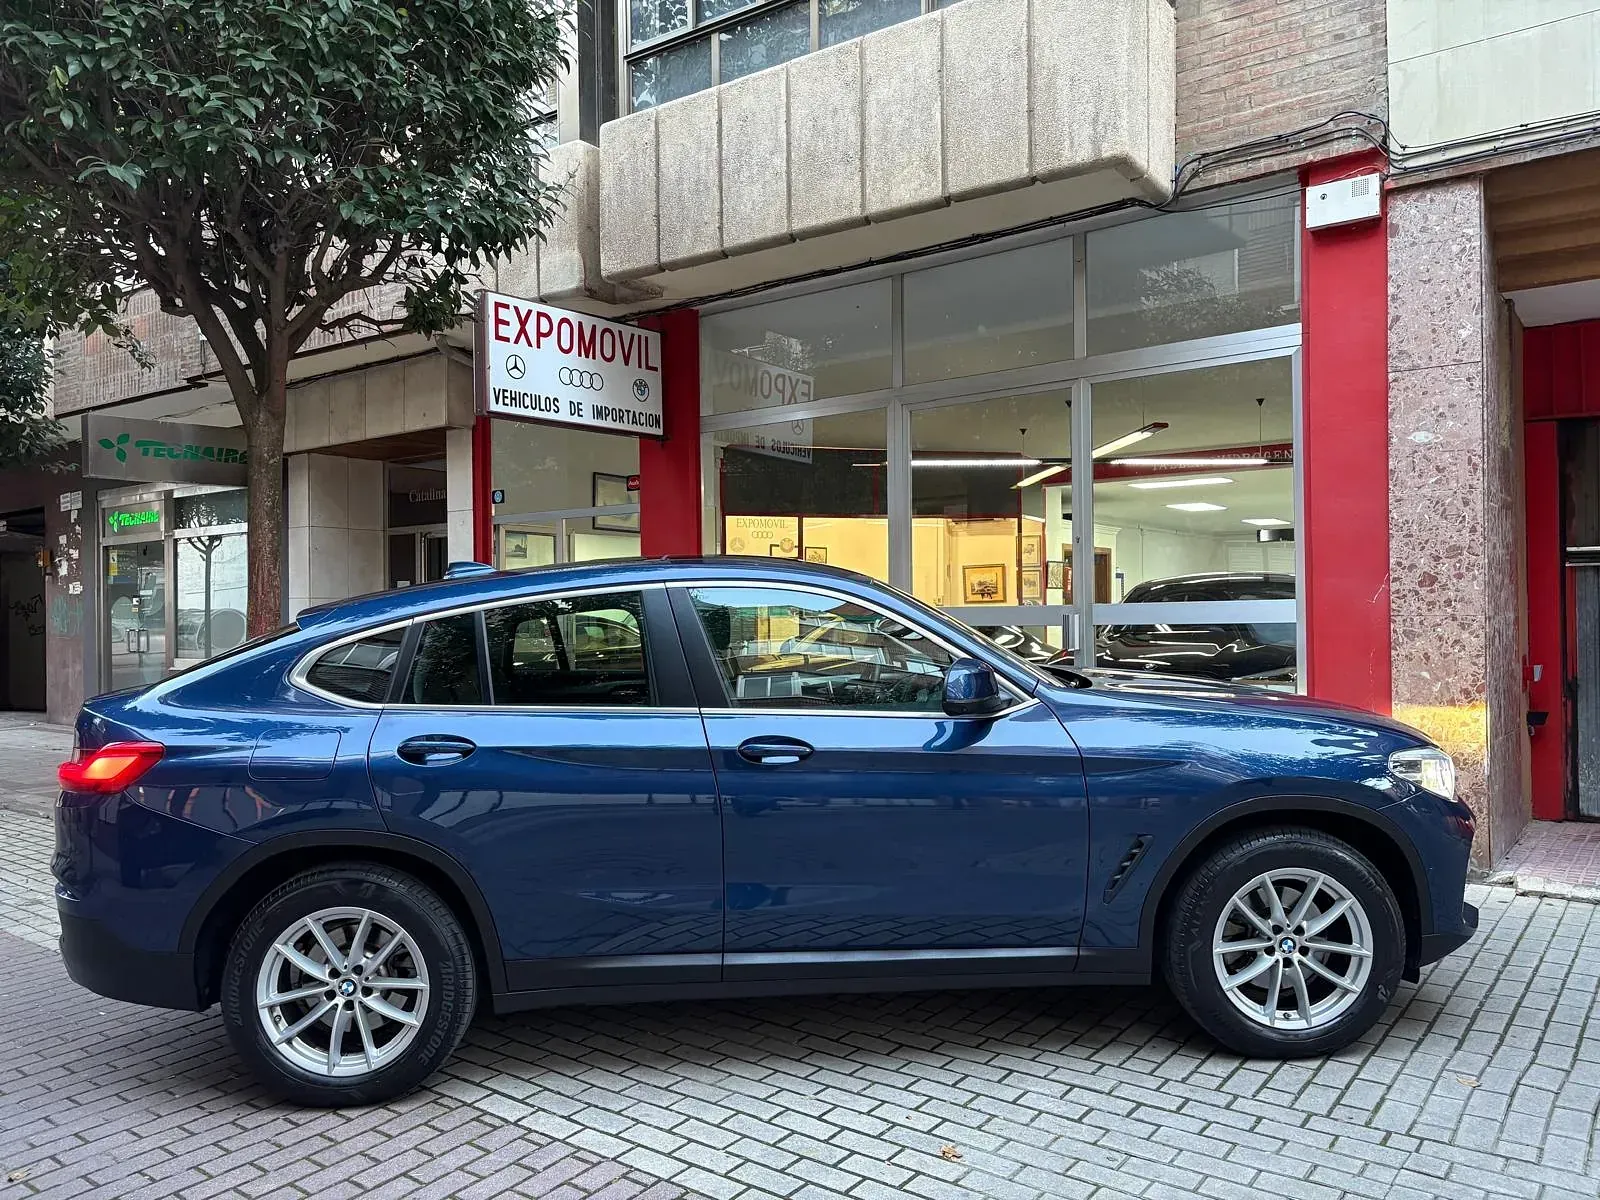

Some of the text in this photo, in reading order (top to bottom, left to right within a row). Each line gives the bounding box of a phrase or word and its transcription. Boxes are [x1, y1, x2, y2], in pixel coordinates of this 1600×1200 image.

[494, 301, 659, 372] EXPOMOVIL
[493, 387, 661, 429] VEHICULOS DE IMPORTACION
[736, 517, 790, 529] EXPOMOVIL
